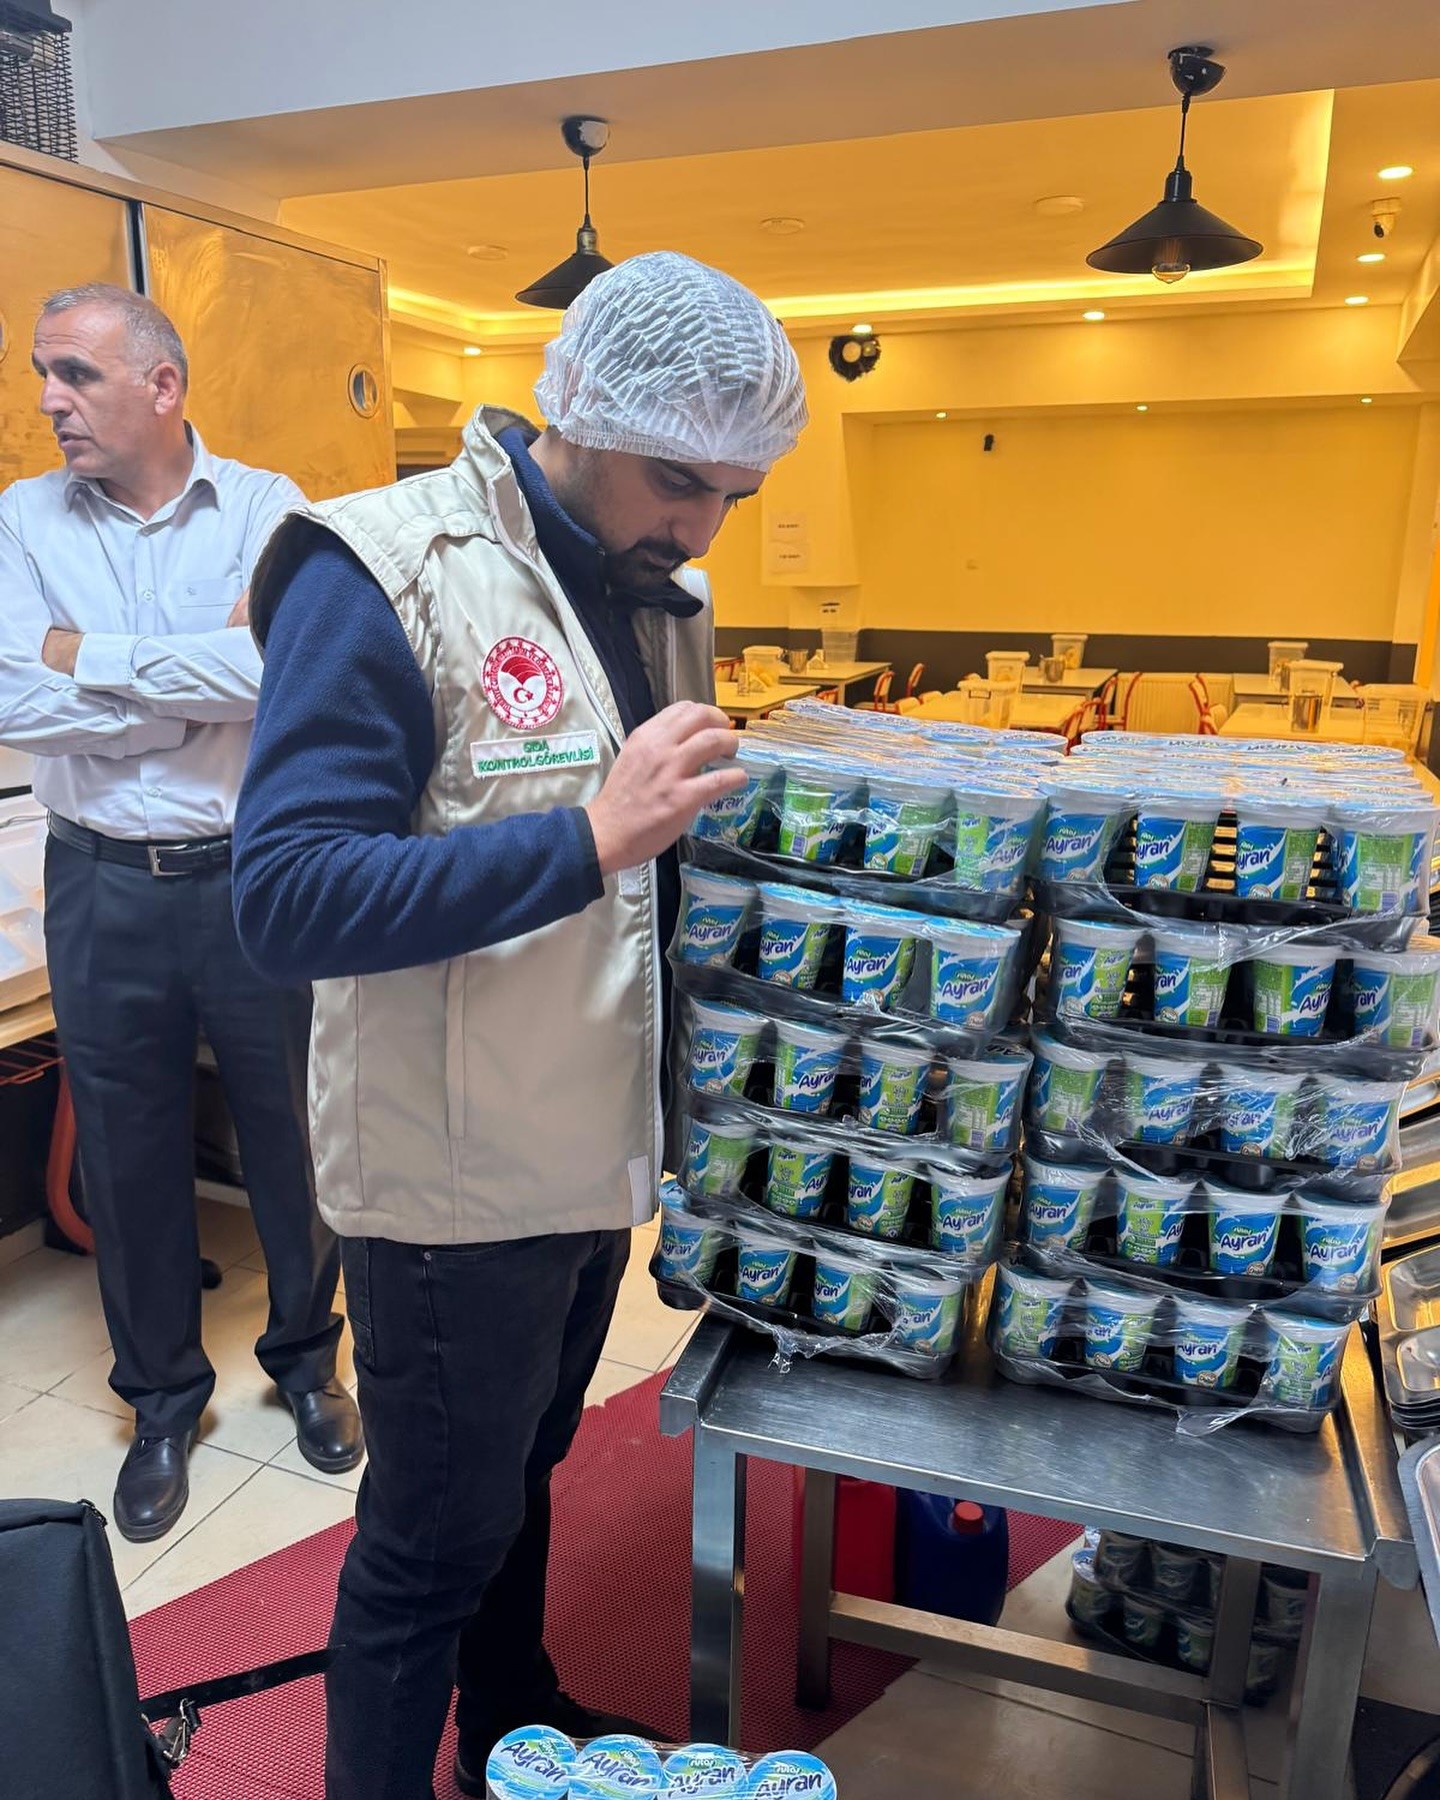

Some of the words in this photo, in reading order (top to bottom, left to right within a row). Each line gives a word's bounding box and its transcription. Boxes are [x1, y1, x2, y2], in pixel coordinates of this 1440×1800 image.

[478, 755, 534, 773] KONTROL
[1047, 833, 1092, 853] Ayran
[689, 923, 732, 941] Ayran
[846, 954, 887, 975] Ayran
[942, 978, 989, 1000] Ayran
[849, 1185, 872, 1199] yran
[943, 1212, 985, 1231] Ayran
[1221, 1231, 1267, 1251] Ayran
[1311, 1244, 1358, 1262] Ayran
[742, 1266, 779, 1283] Ayran
[501, 1741, 568, 1783] Ayran
[582, 1751, 651, 1788] Ayran
[668, 1765, 735, 1798] Ayran
[754, 1772, 823, 1800] Ayran
